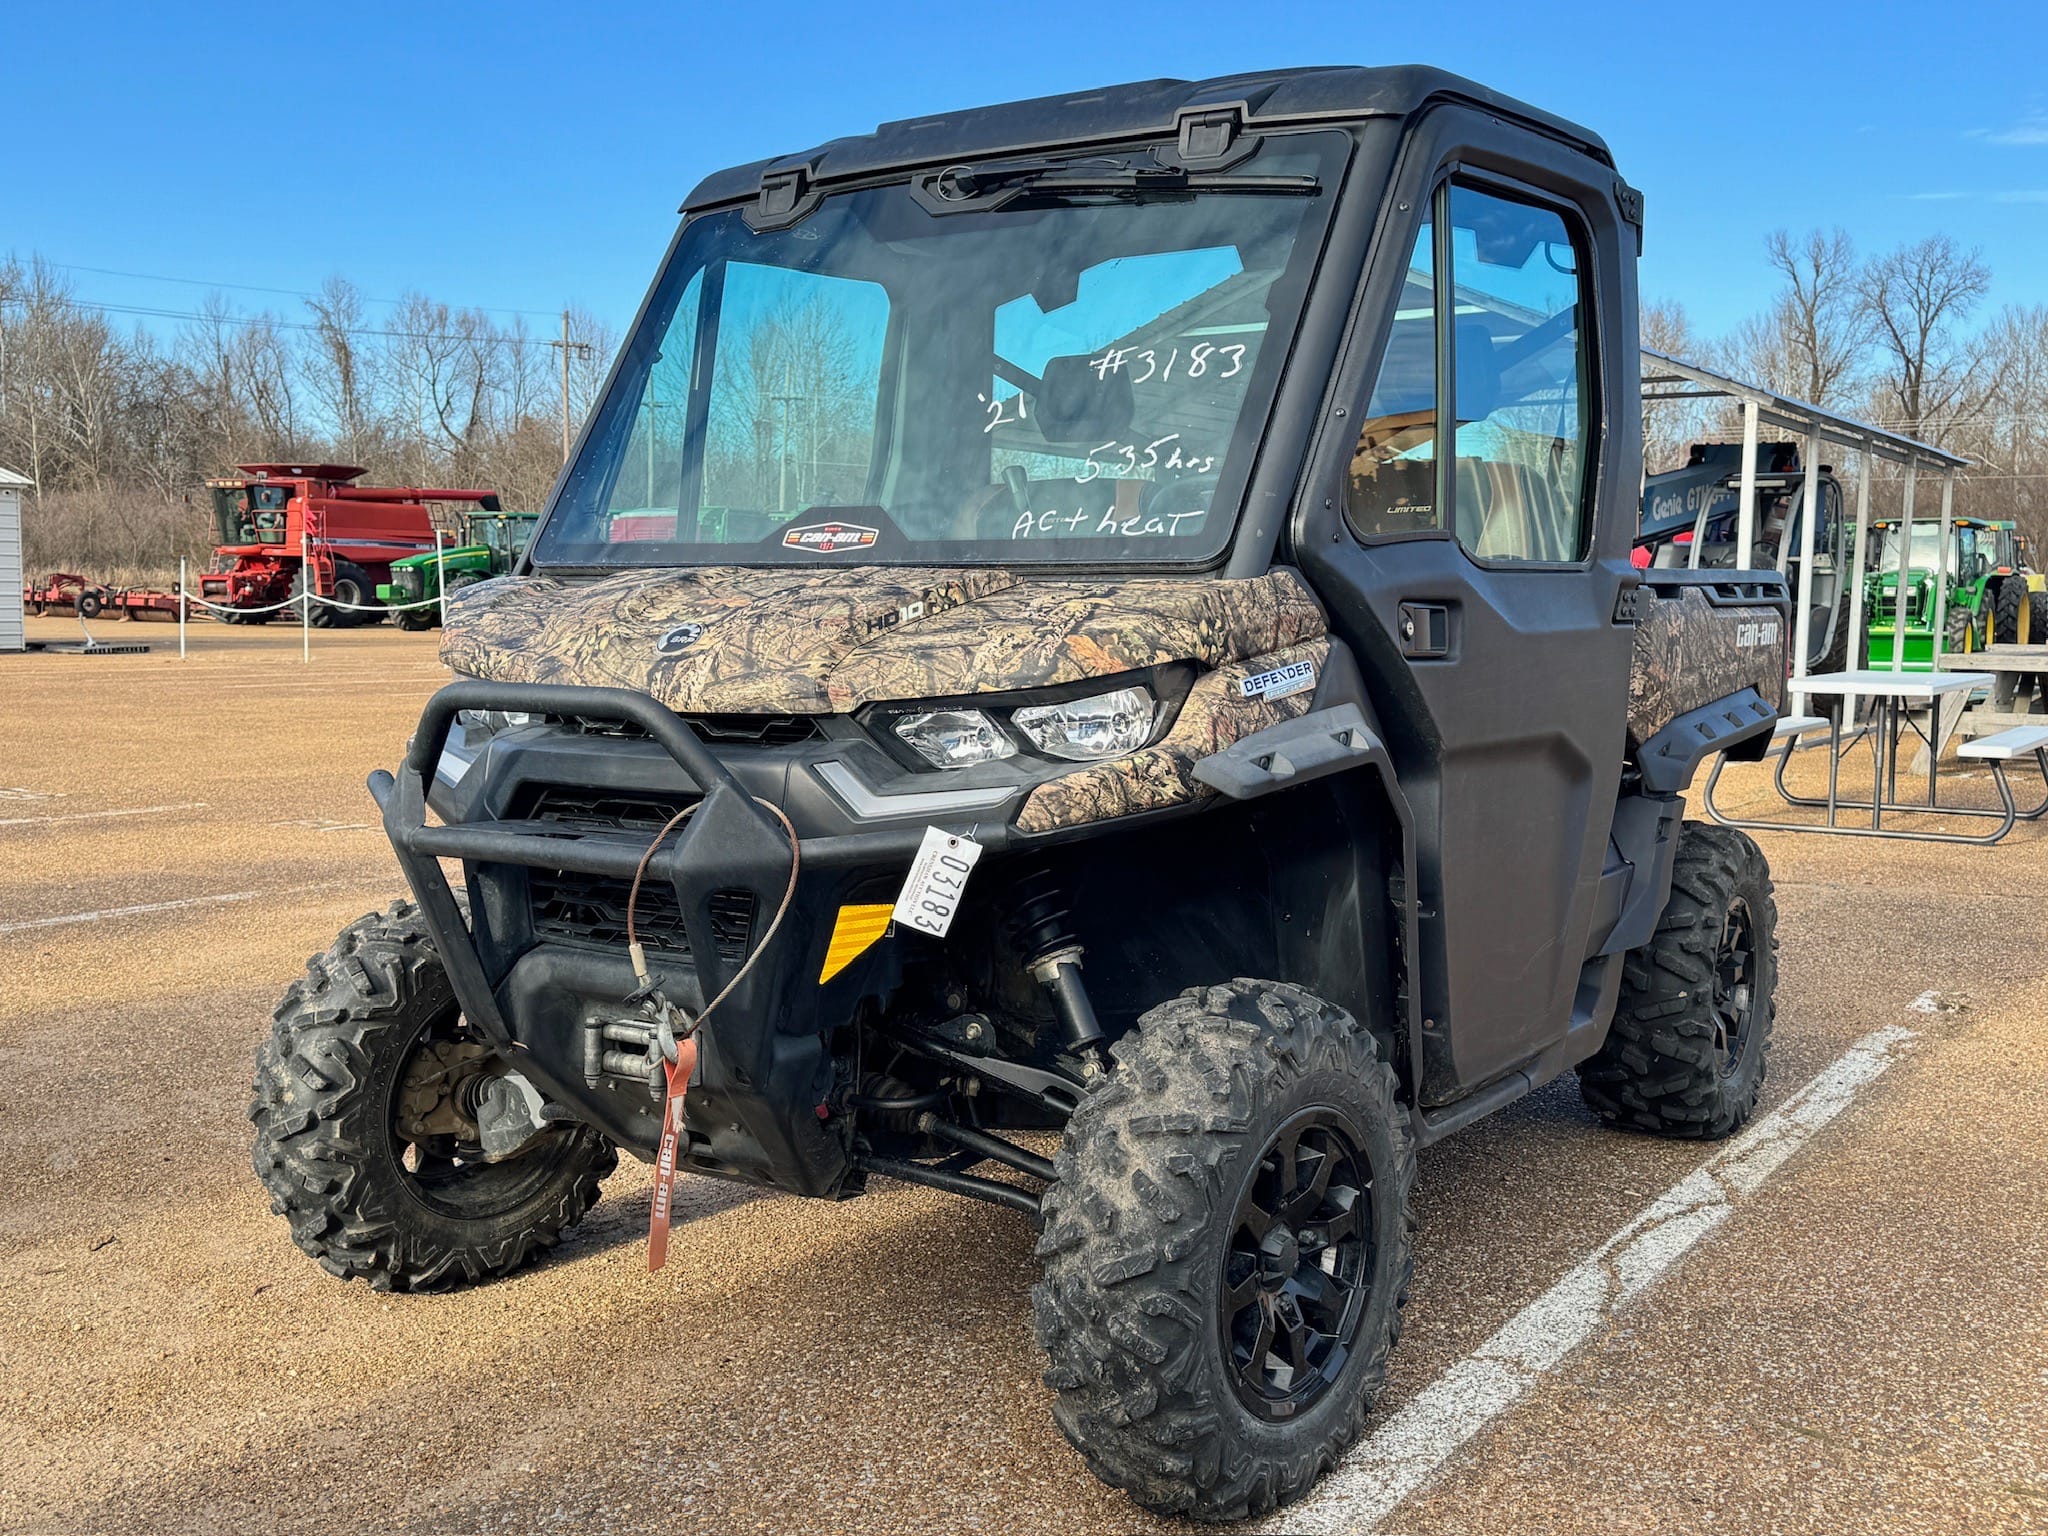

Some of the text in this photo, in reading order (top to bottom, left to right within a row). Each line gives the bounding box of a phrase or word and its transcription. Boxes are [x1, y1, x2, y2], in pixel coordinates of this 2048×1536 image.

[1089, 342, 1246, 383] #3183
[1386, 505, 1432, 514] LIMITED
[1652, 493, 1683, 521] Genie
[1736, 620, 1778, 648] can-am
[1243, 661, 1313, 693] DEFENDER
[914, 855, 970, 932] 03183
